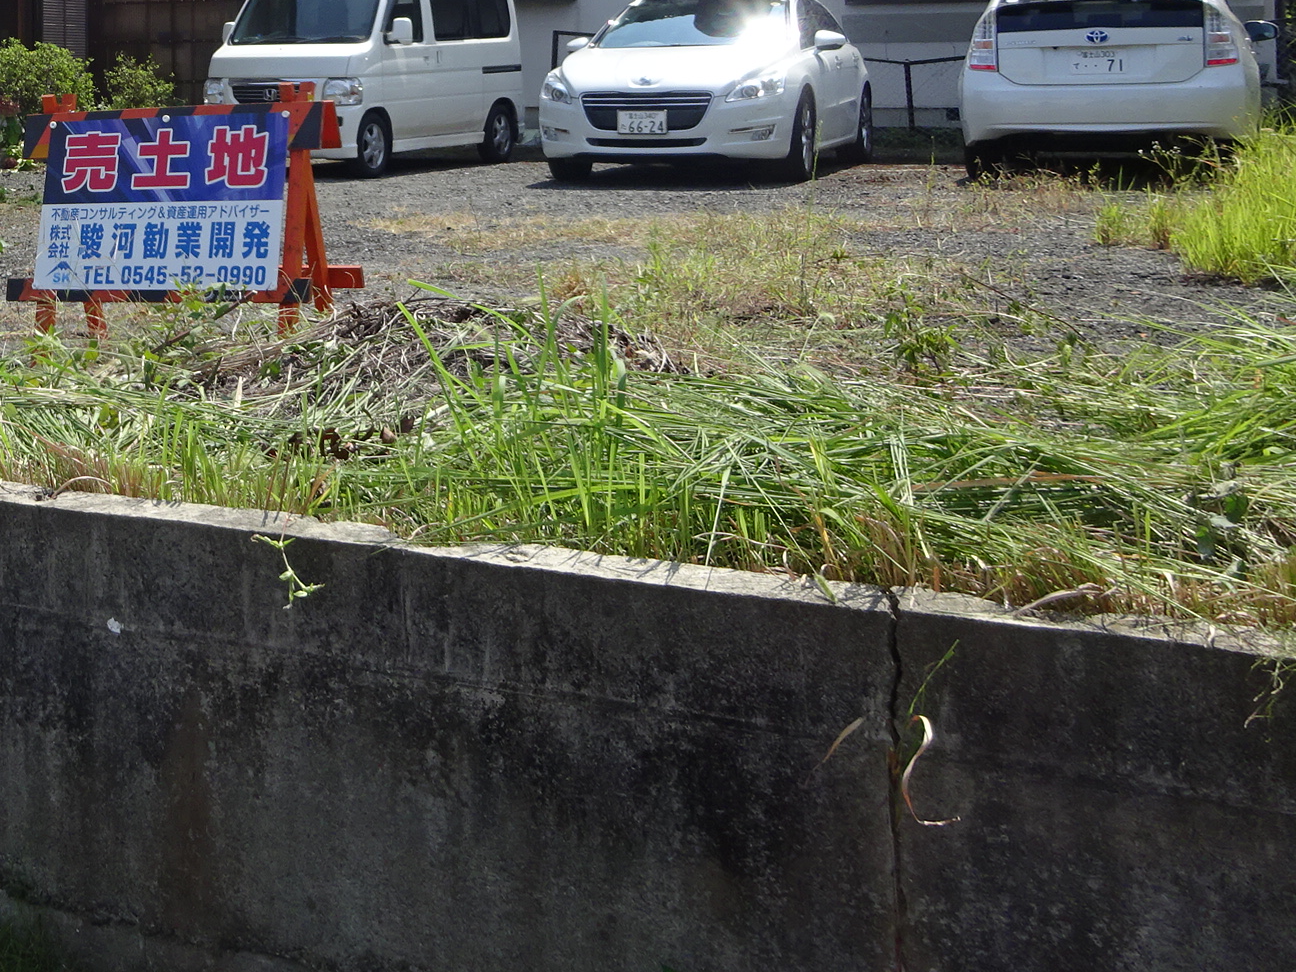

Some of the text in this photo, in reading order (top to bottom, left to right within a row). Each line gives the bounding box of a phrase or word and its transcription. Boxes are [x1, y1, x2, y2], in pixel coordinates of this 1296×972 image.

[628, 120, 664, 133] 66-24
[61, 125, 269, 193] 売土地
[49, 224, 71, 240] 株式
[78, 221, 271, 259] 駿河勧業開発
[47, 242, 70, 258] 会社
[83, 265, 266, 285] TEL 0545-52-0990
